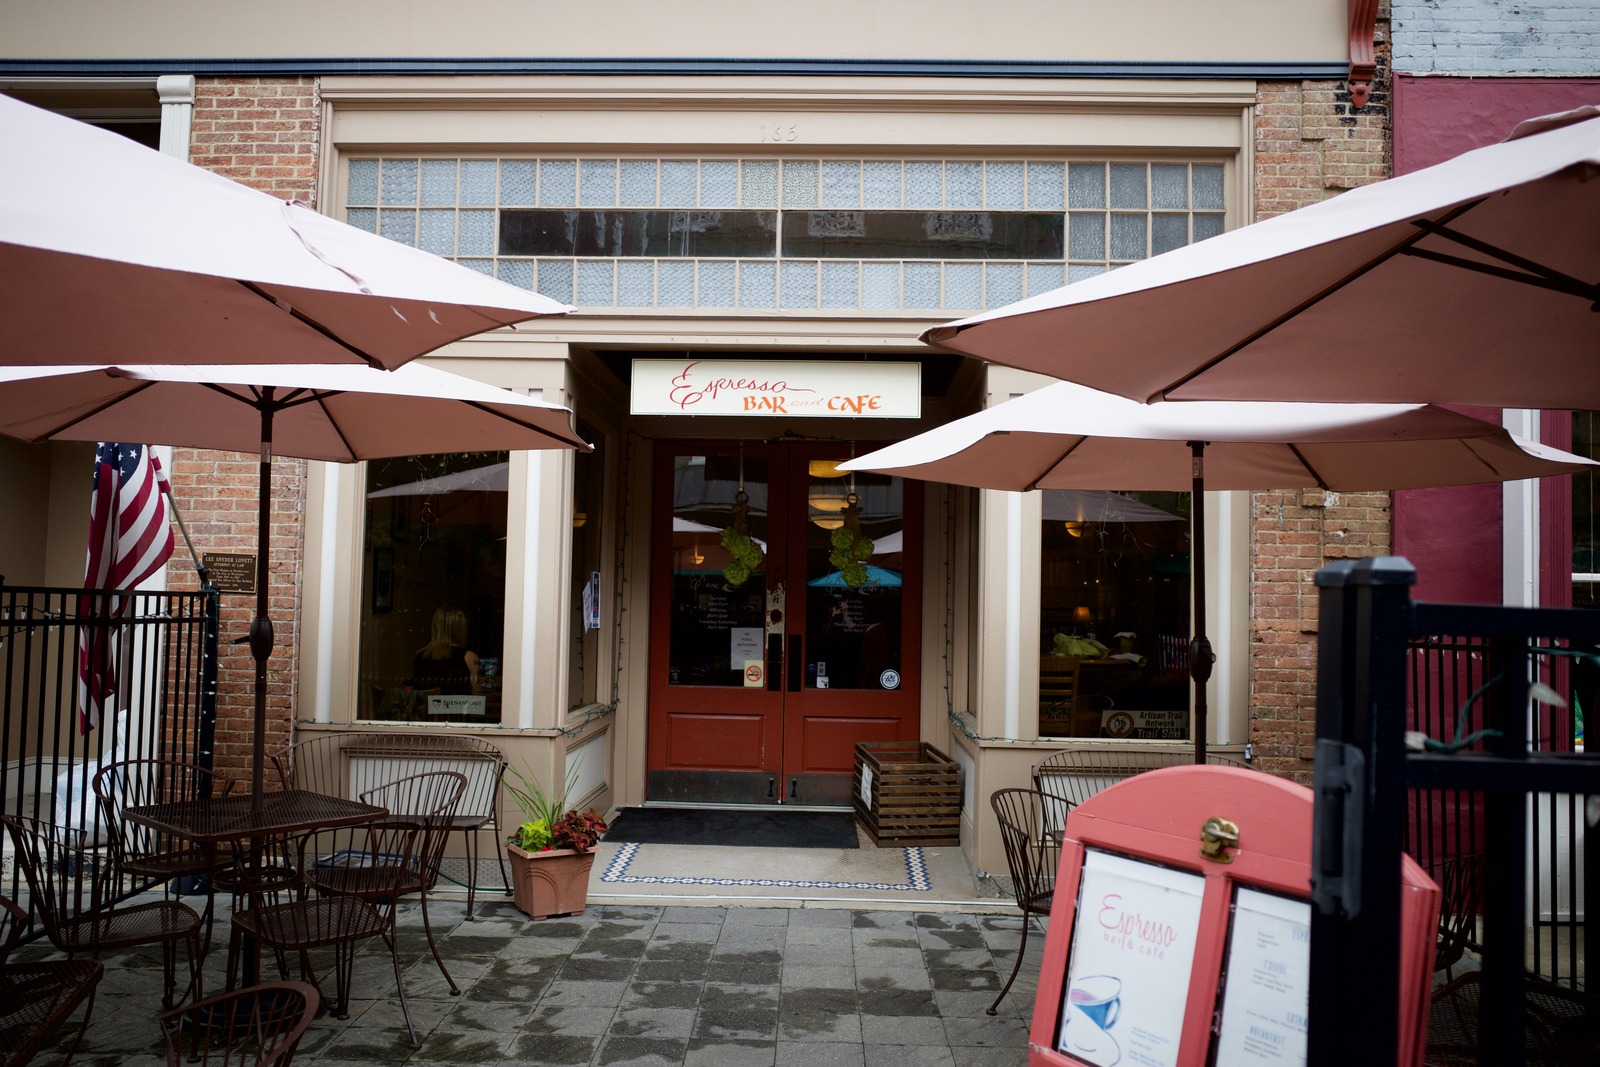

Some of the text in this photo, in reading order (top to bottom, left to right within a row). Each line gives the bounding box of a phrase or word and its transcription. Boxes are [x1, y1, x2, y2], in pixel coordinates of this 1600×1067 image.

[669, 360, 816, 410] Espresso
[743, 395, 882, 415] BAR and CAFE
[1139, 711, 1184, 720] Artisan Trail
[1145, 719, 1175, 728] Network
[1136, 728, 1159, 739] Trail
[1098, 893, 1178, 951] Espresso
[1103, 931, 1122, 945] bar
[1126, 939, 1134, 950] &
